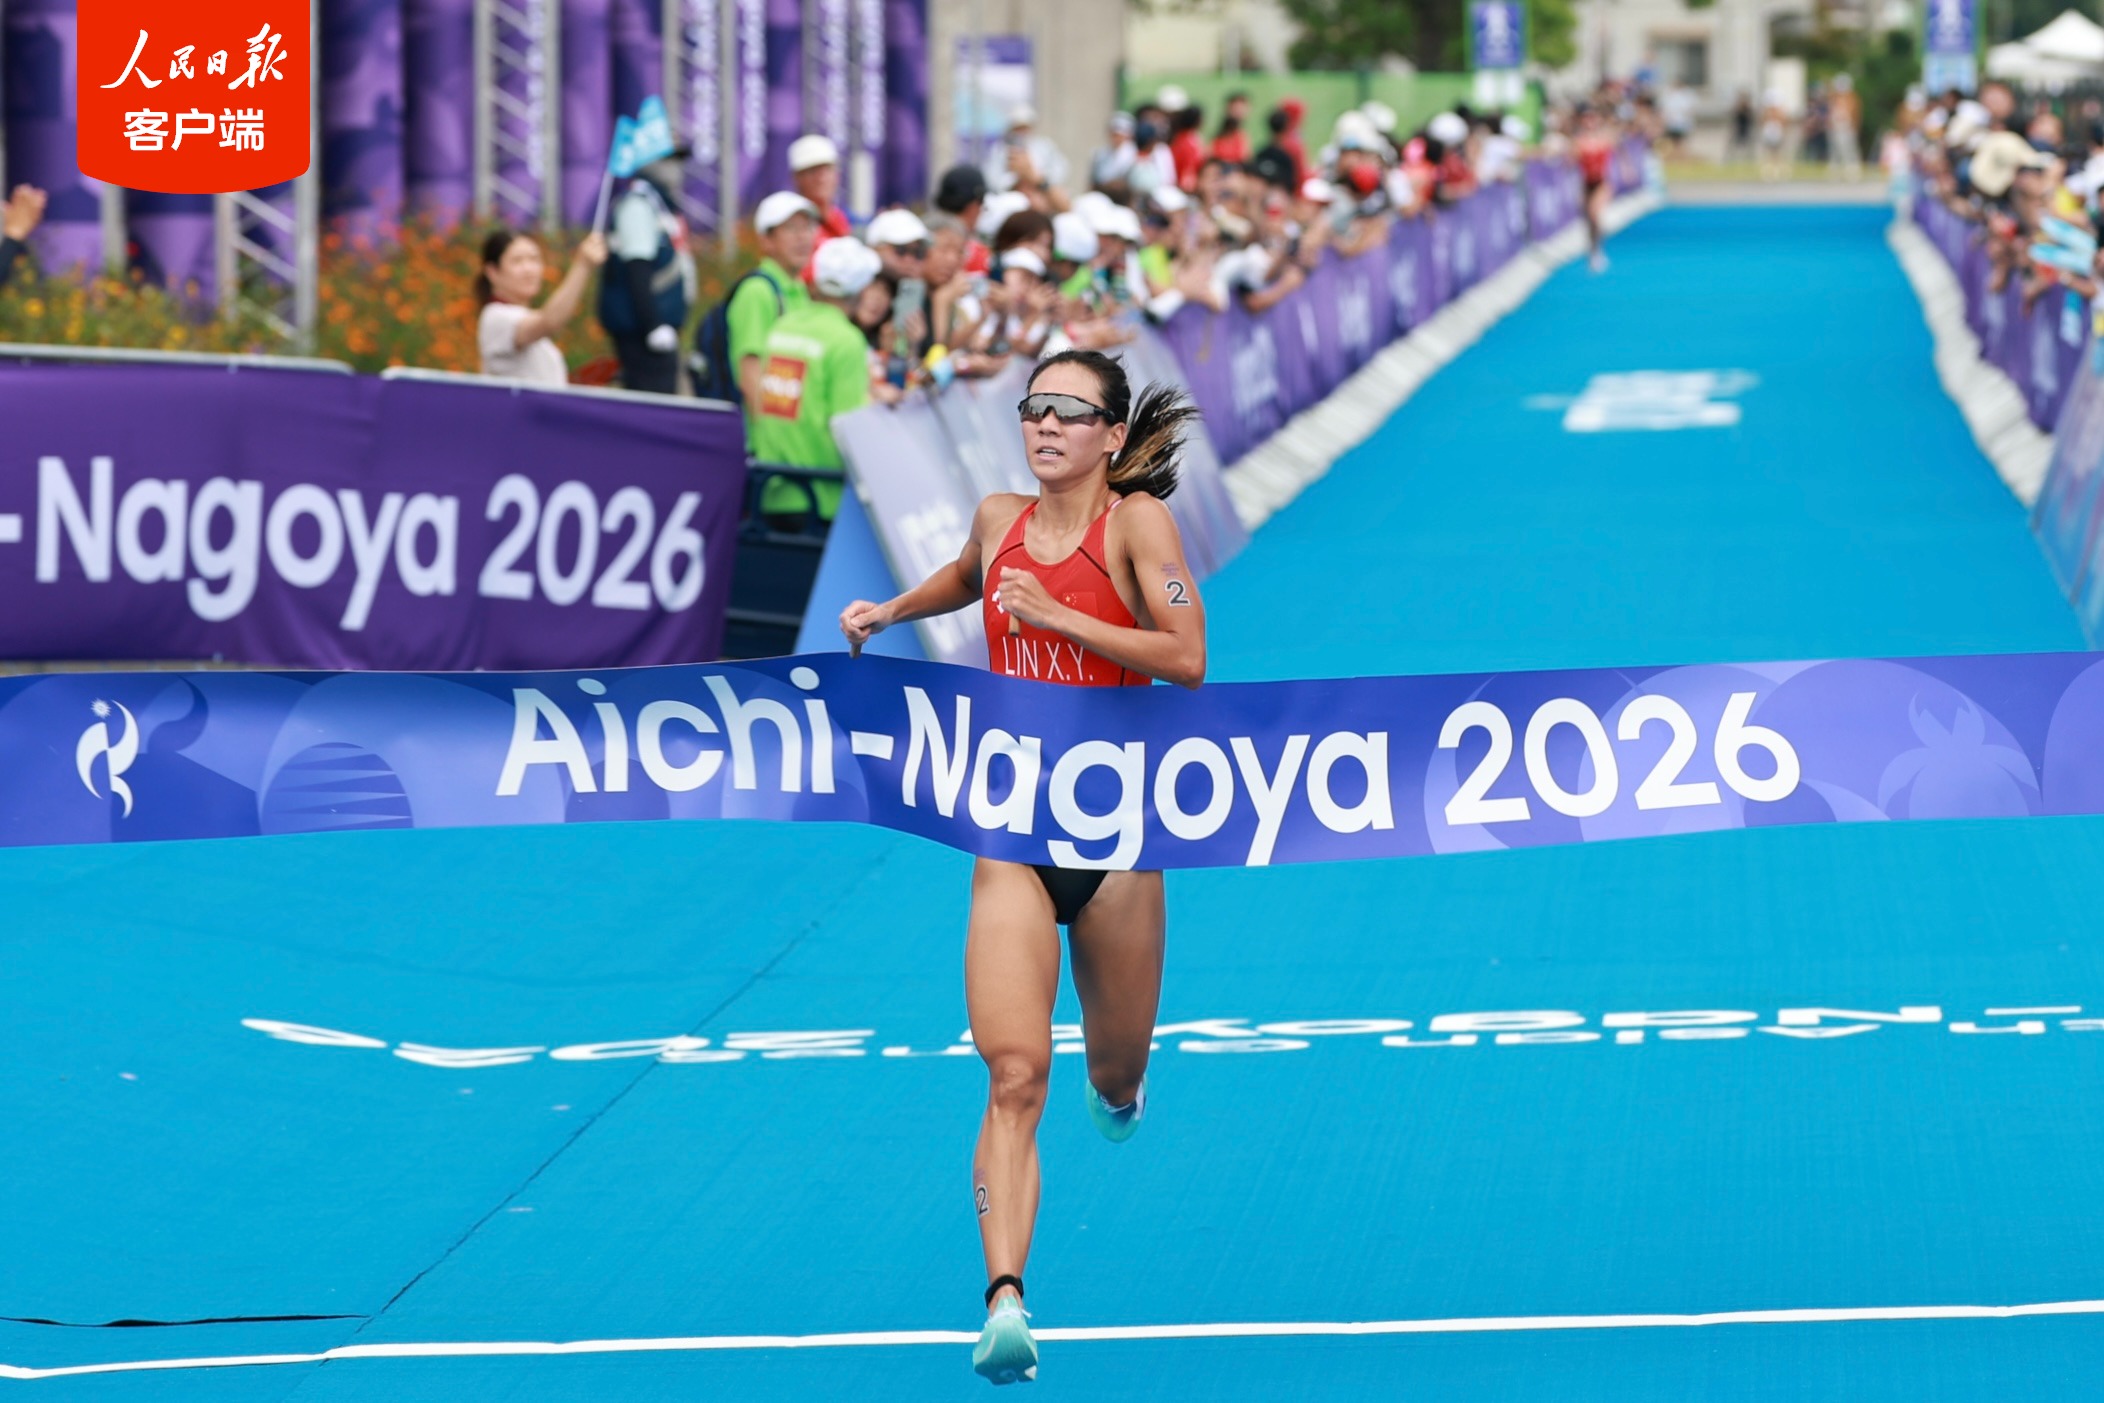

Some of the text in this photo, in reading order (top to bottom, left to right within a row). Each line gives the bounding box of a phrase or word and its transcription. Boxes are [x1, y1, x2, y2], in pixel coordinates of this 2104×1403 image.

[478, 474, 706, 611] 2026
[1165, 578, 1191, 607] 2
[1002, 636, 1039, 679] LIN
[494, 665, 1802, 871] Aichi-Nagoya 2026
[975, 1184, 991, 1218] 2
